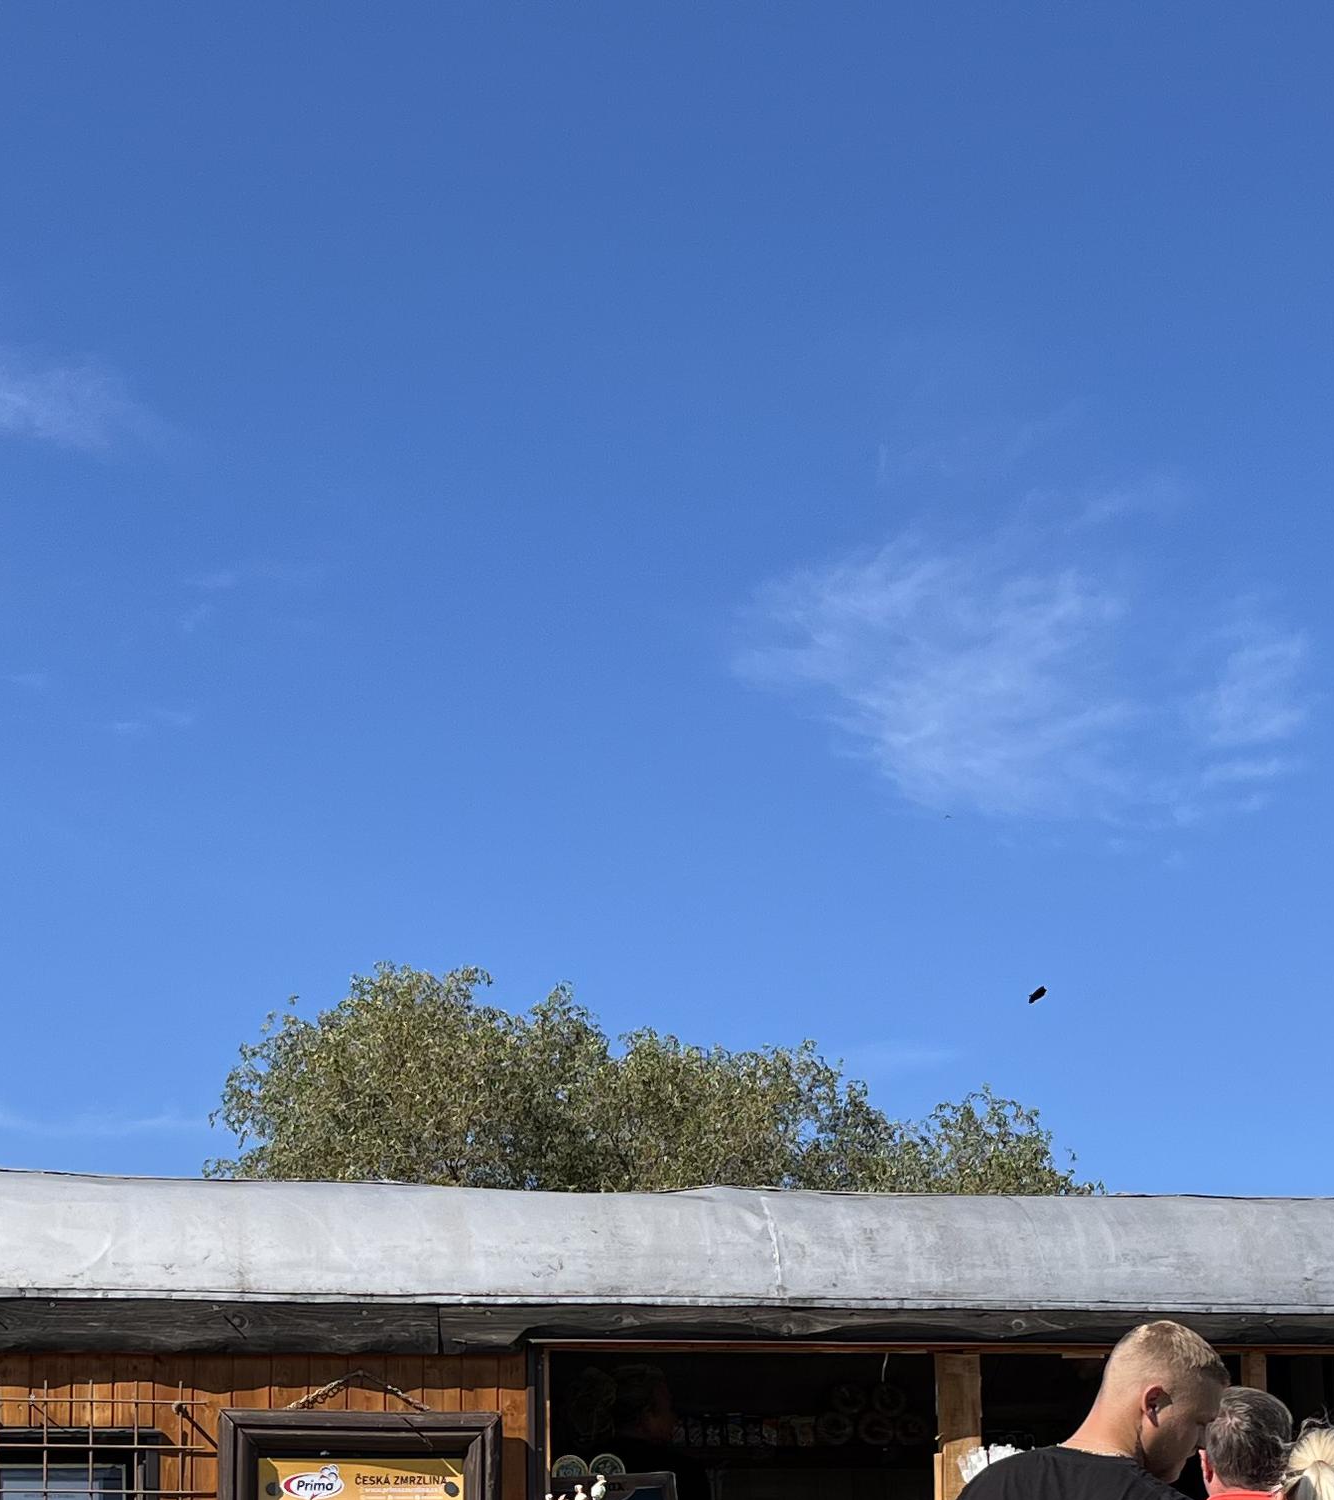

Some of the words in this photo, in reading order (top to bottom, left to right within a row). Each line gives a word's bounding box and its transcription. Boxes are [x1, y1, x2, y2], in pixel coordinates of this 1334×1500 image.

[297, 1479, 335, 1492] Prima
[355, 1472, 389, 1486] ČESKÁ
[394, 1475, 447, 1486] ZMRZLINA
